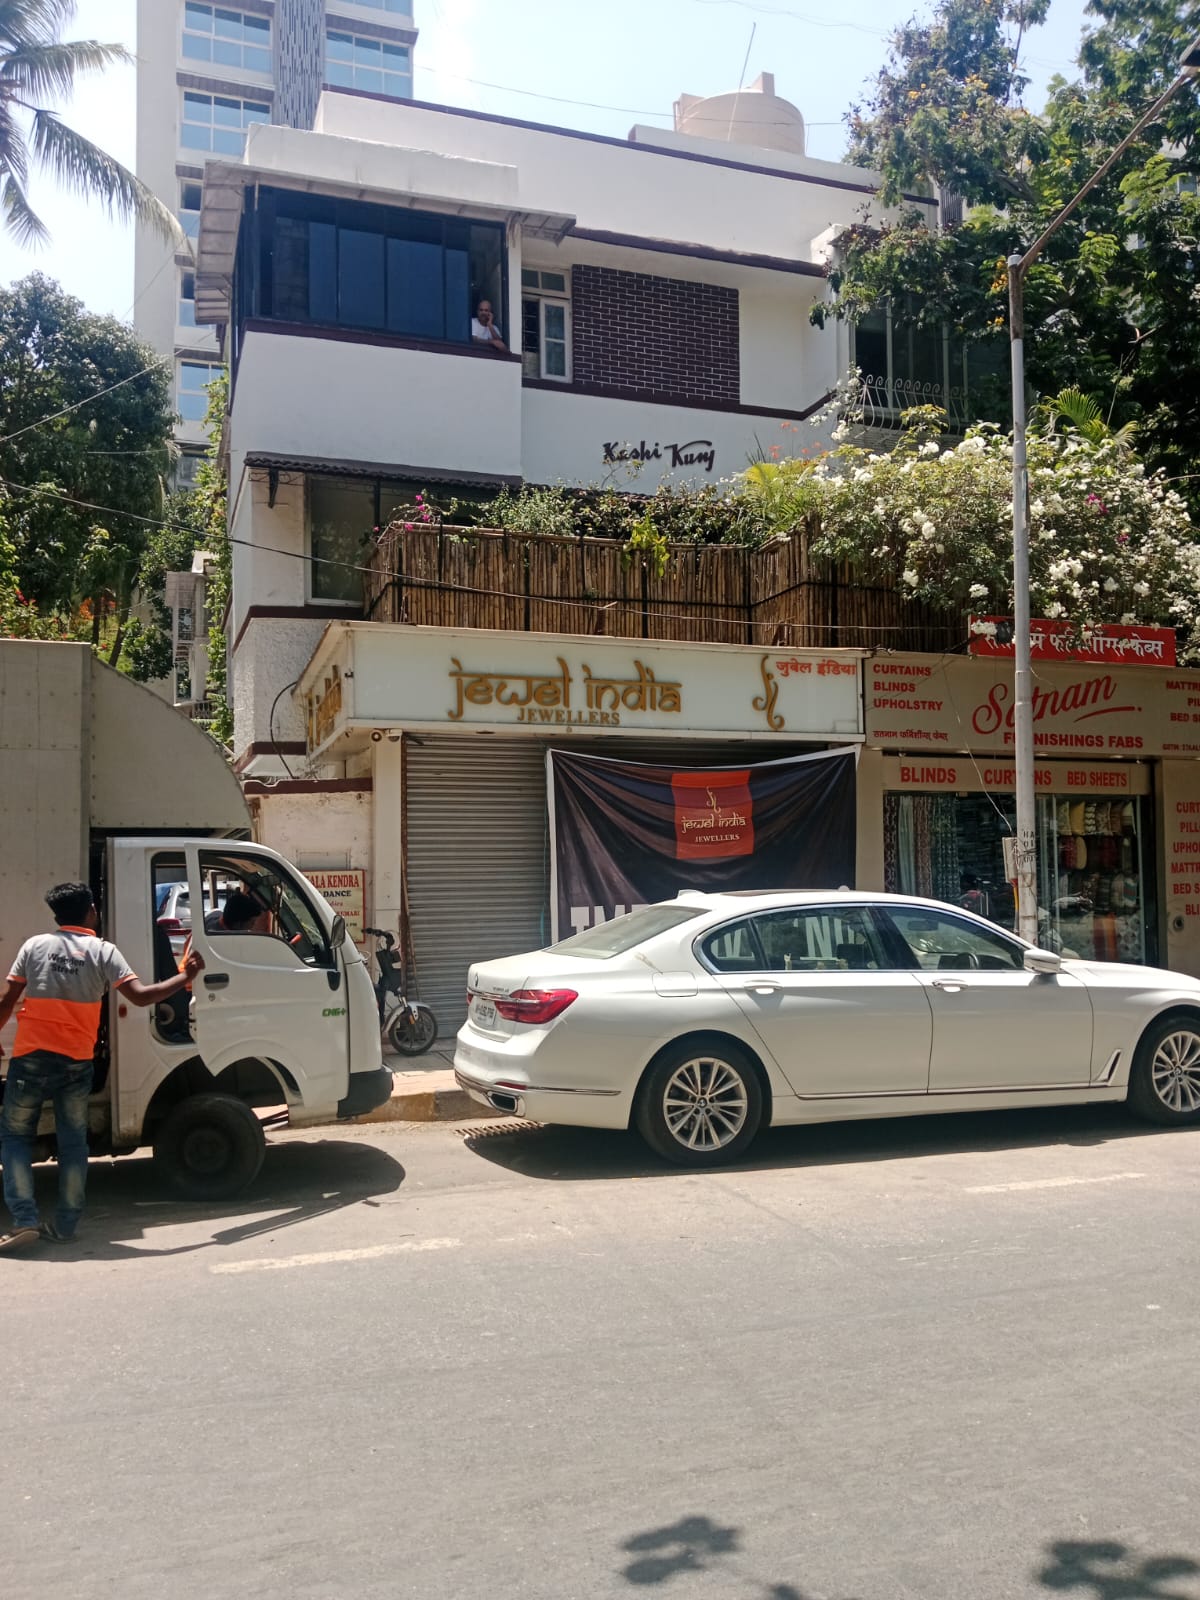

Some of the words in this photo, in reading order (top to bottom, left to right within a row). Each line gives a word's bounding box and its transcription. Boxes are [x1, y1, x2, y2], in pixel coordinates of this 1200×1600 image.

[664, 440, 715, 471] Kunj
[873, 664, 932, 676] CURTAINS
[448, 656, 573, 720] jewel
[581, 660, 682, 712] india
[873, 681, 916, 692] BLINDS
[1166, 681, 1200, 691] MATTR
[873, 699, 943, 711] UPHOLSTRY
[517, 707, 620, 725] JEWELLERS
[1170, 713, 1189, 722] BED
[1003, 732, 1104, 748] FNISHINGS
[1108, 736, 1143, 748] FABS
[901, 767, 956, 783] BLINDS
[984, 769, 1052, 785] CURNS
[1067, 771, 1086, 786] BED
[1089, 772, 1127, 787] SHEETS
[681, 813, 714, 833] jewel
[718, 812, 746, 827] india
[1180, 822, 1200, 832] PILL
[695, 834, 740, 842] JEWELLERS
[327, 875, 360, 888] KENDRA
[1173, 883, 1192, 894] BED
